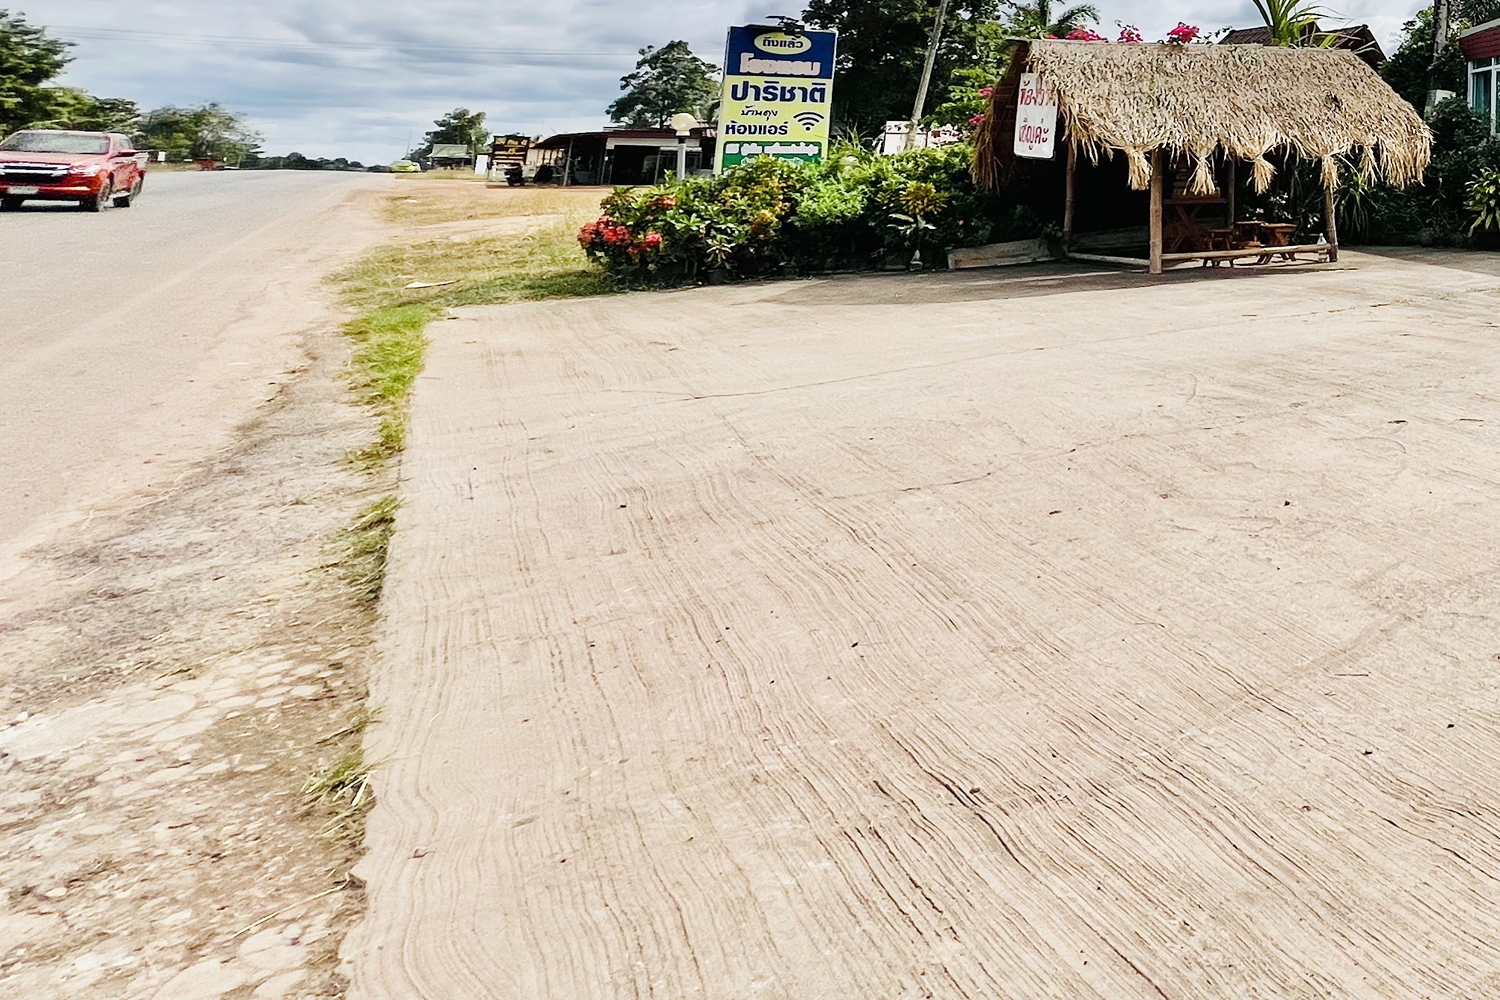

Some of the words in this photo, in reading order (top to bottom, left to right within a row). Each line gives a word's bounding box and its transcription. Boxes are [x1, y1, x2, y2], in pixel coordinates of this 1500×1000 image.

[731, 80, 827, 103] ปาริชาติ
[740, 104, 779, 121] บ้านดุง
[725, 120, 789, 136] ห้องแอร์
